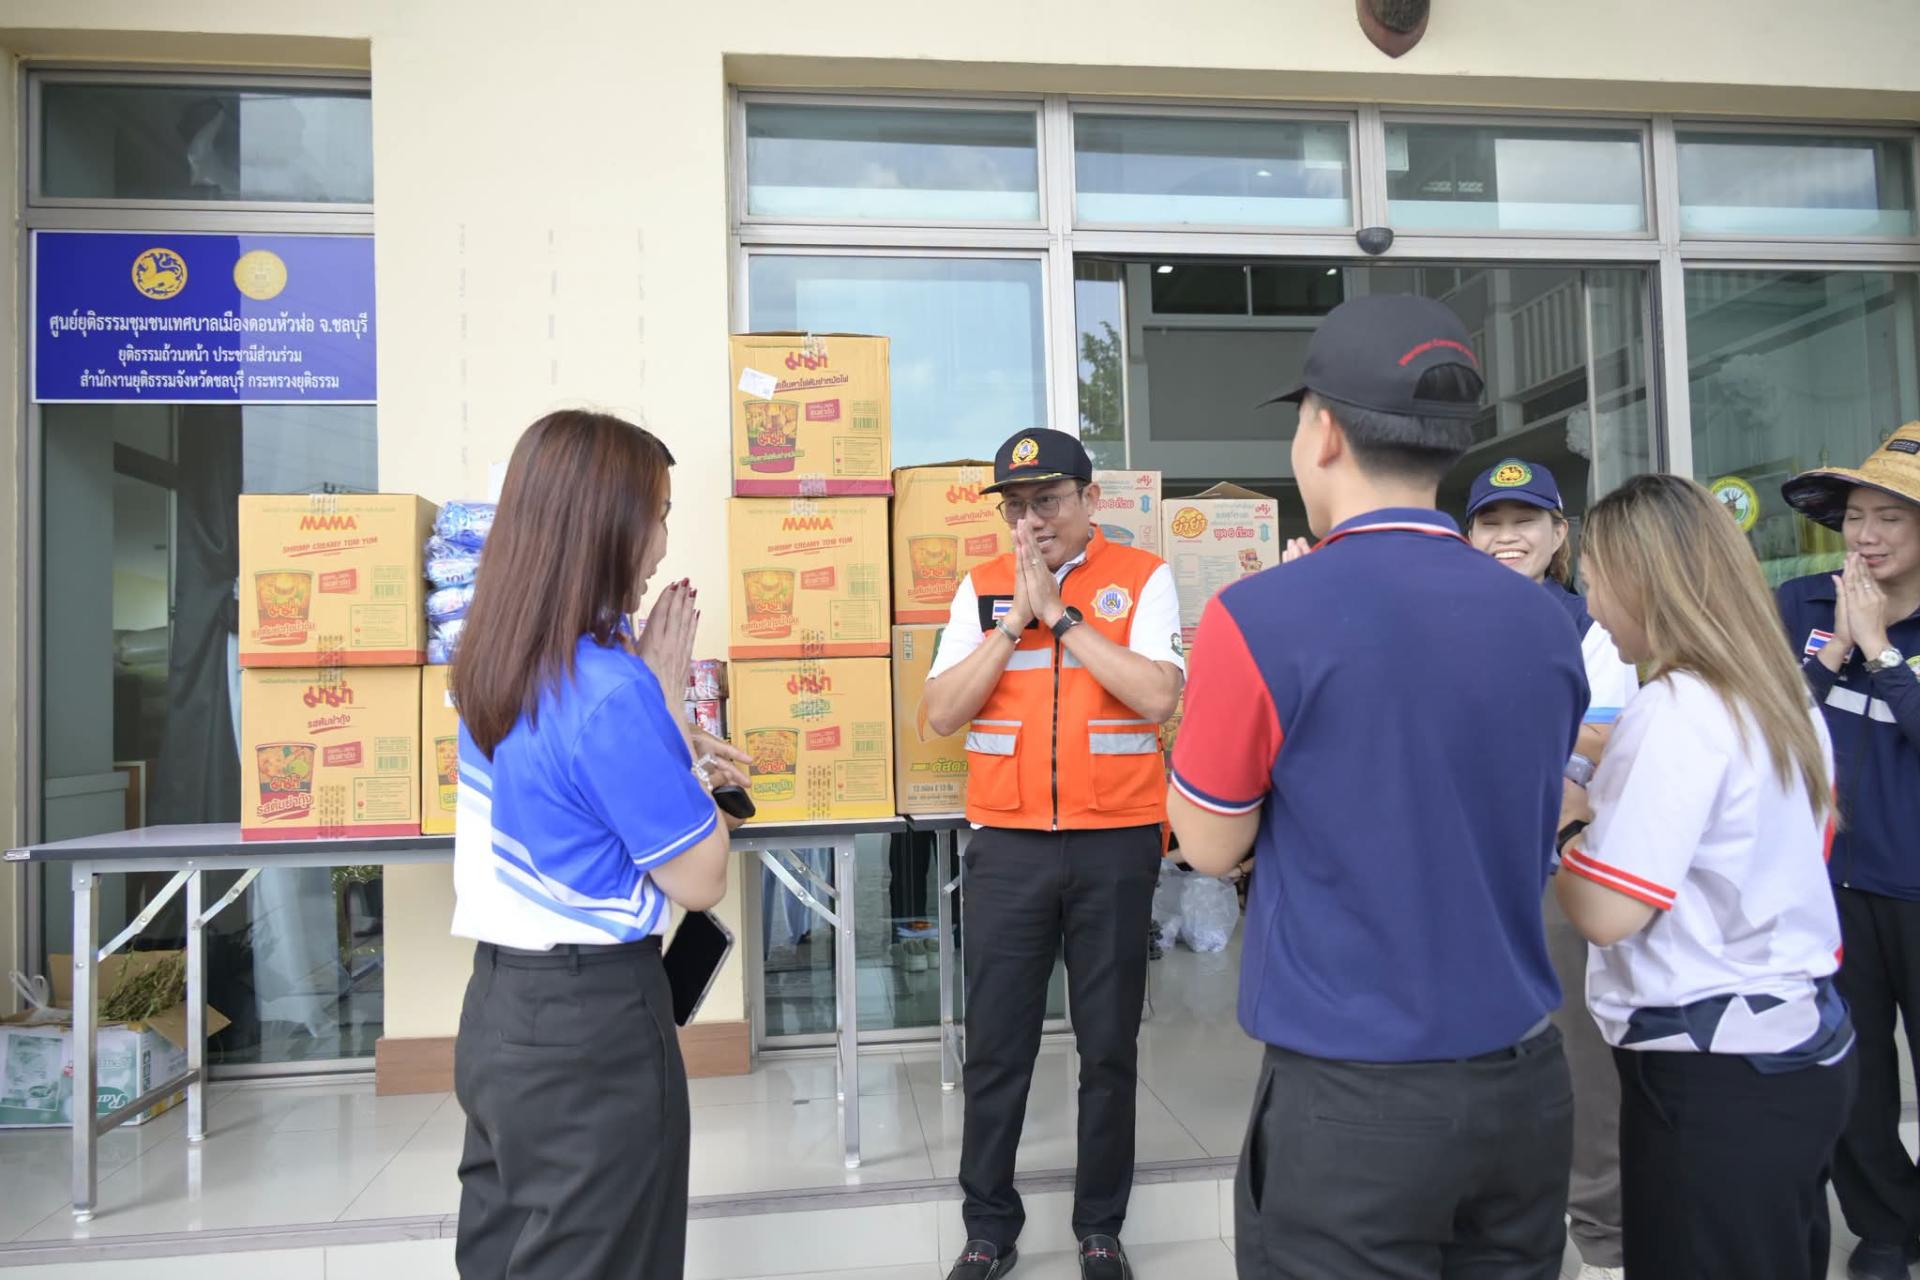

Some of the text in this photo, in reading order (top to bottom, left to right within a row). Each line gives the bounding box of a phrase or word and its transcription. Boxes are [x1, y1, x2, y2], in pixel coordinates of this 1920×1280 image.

[319, 311, 369, 337] จ.ชลบุรี
[118, 343, 302, 367] ยุติธรรมถ้วนหน้า ประชามีส่วนร่วม
[80, 368, 339, 393] สำนักงานยุติธรรมจังหวัดชลบุรี กระทรวงยุติธรรม
[300, 515, 357, 531] MAMA
[782, 516, 834, 531] MAMA
[303, 680, 354, 708] มาม่า
